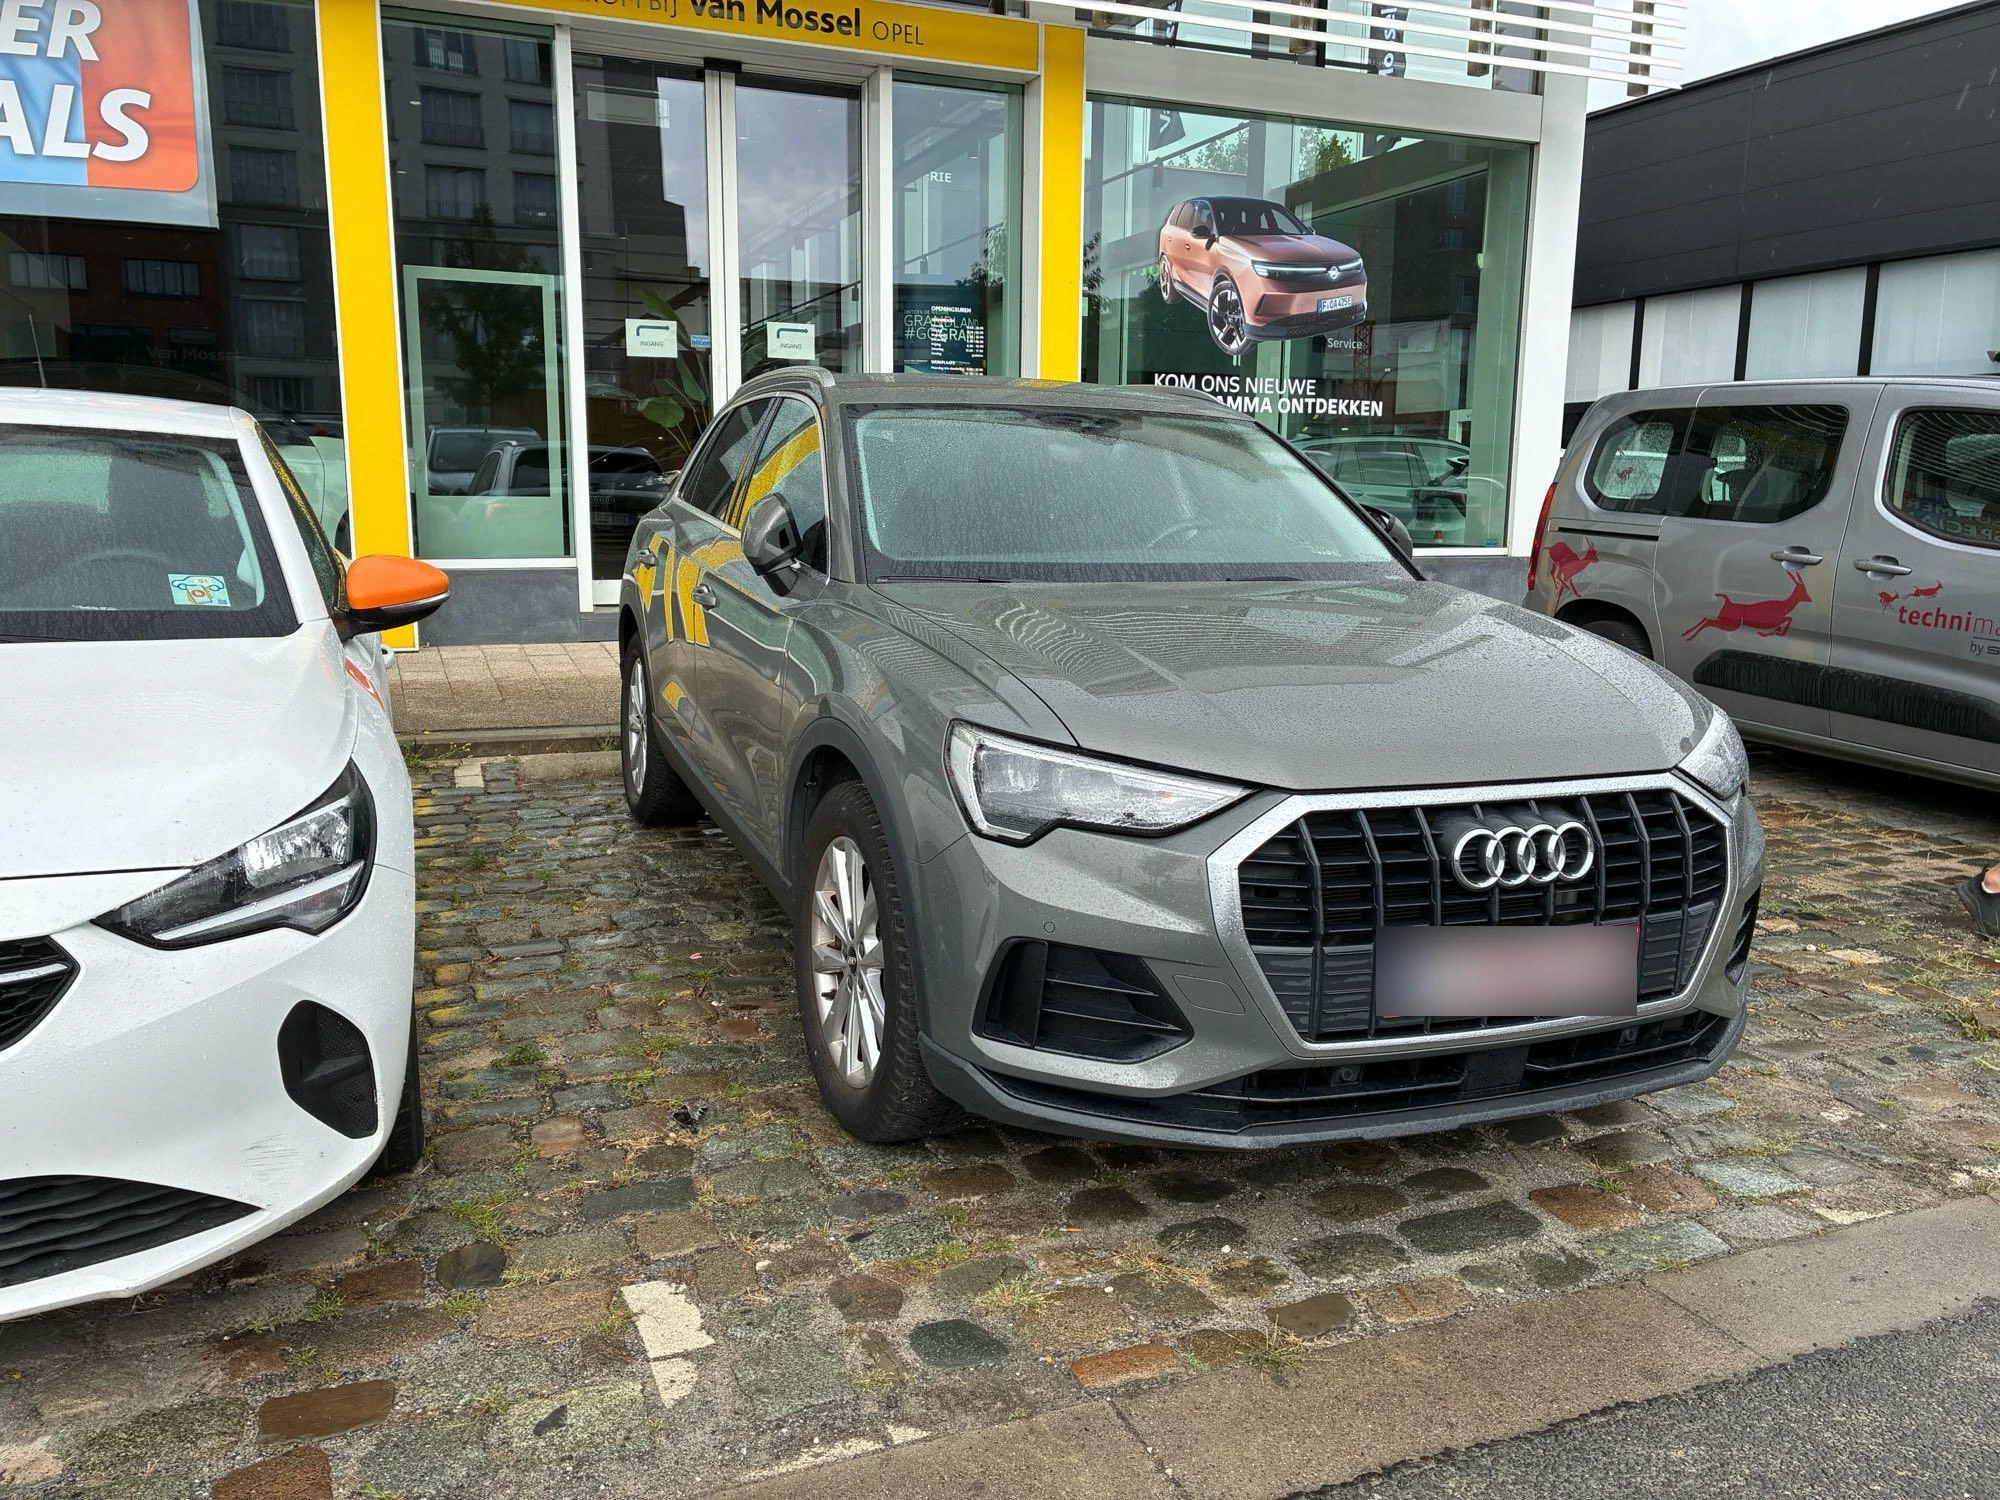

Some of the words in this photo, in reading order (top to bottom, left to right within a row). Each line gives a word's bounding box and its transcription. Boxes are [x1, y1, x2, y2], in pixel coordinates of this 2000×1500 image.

[690, 0, 745, 21] Van
[756, 0, 861, 37] Mossel
[872, 20, 925, 46] OPEL
[928, 171, 952, 183] RIE
[640, 340, 664, 348] INGANG
[780, 342, 802, 350] INGANG
[1327, 337, 1363, 349] Service
[1154, 373, 1195, 389] KOM
[1201, 375, 1240, 393] ONS
[1245, 378, 1316, 395] NIEUWE
[1277, 397, 1383, 417] ONTDEKKEN
[1970, 641, 1984, 656] by
